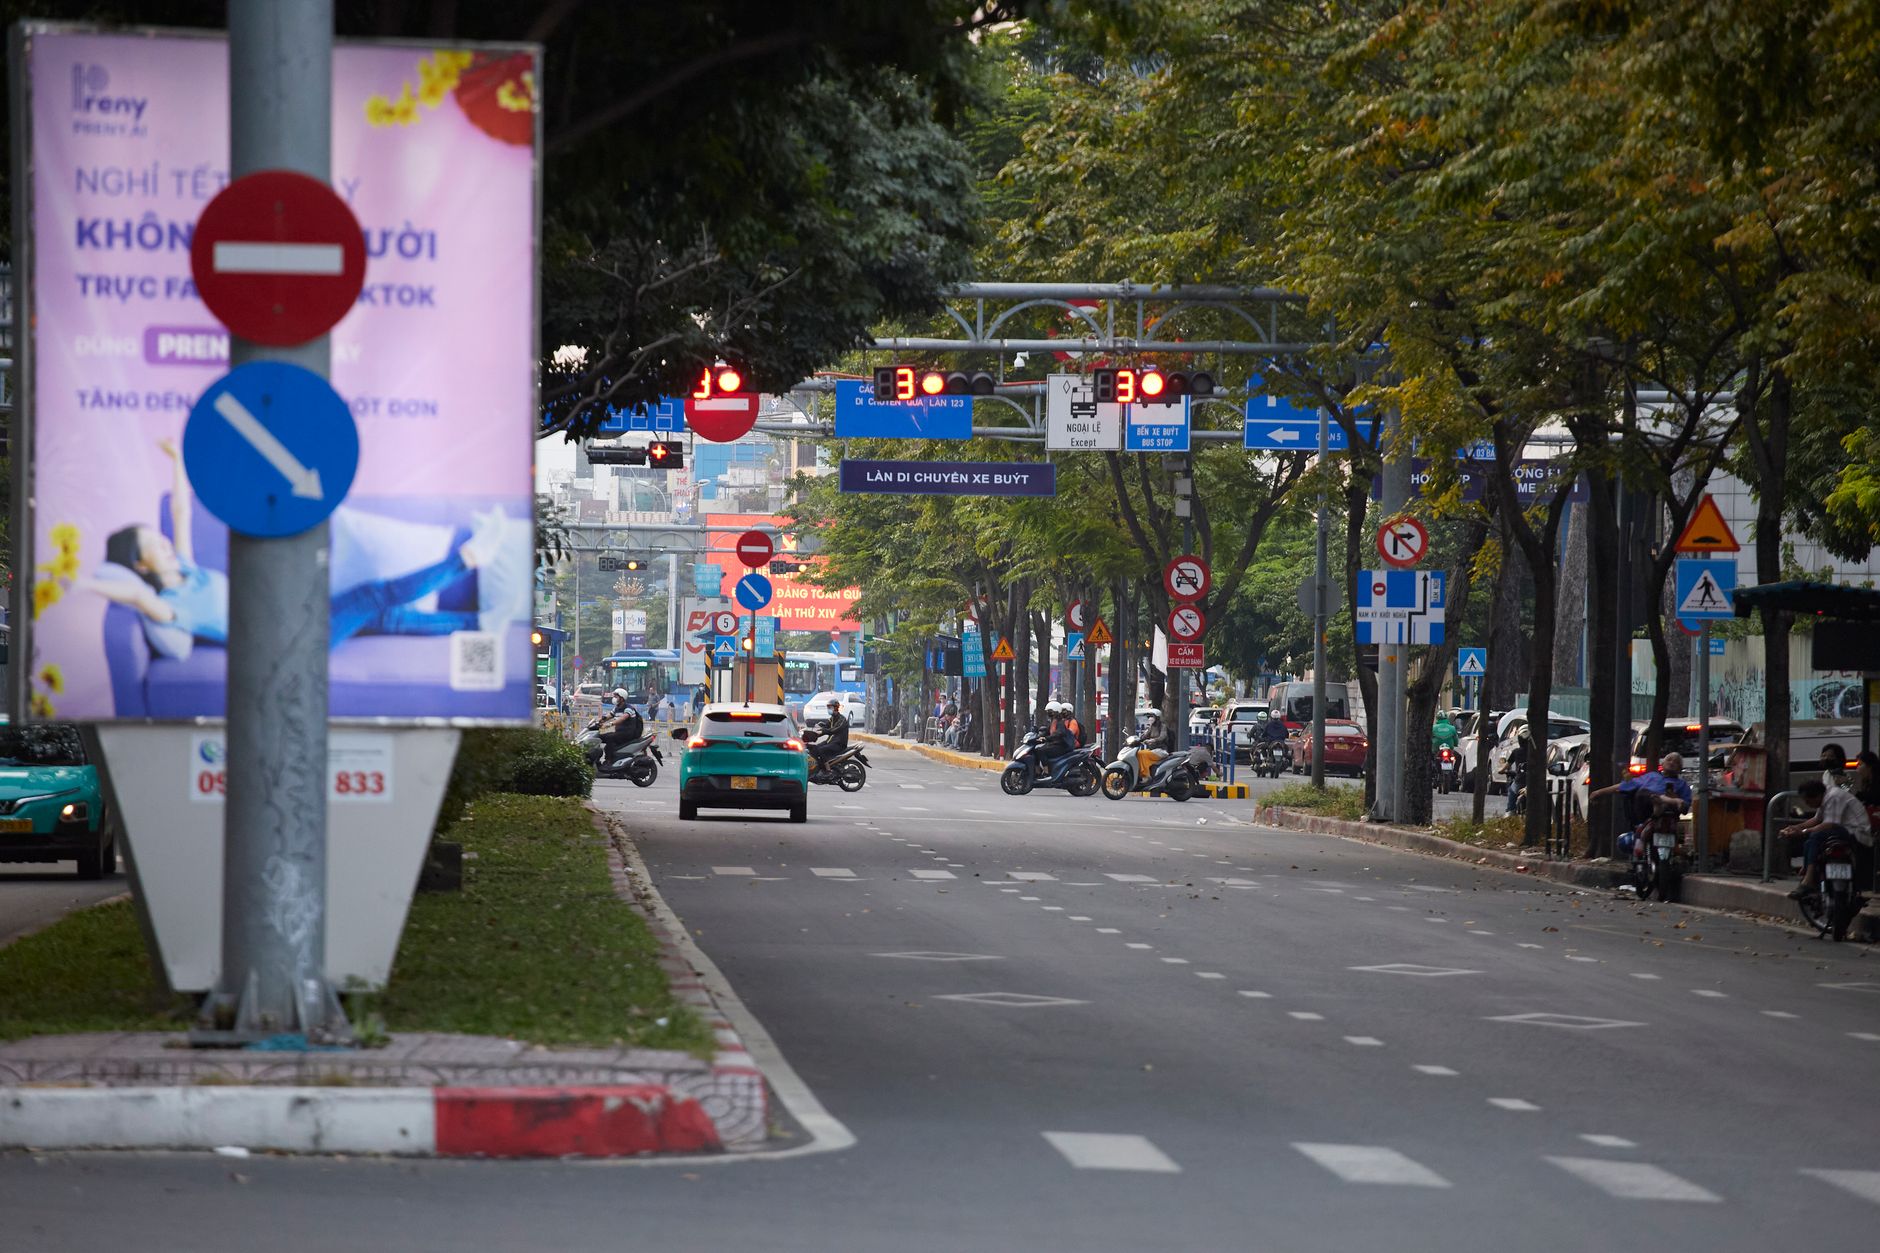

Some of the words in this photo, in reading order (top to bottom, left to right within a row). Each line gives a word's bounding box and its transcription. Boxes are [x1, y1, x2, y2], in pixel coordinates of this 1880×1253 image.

[76, 212, 195, 250] KHÔN
[364, 219, 437, 261] ƯỜI
[165, 276, 200, 301] FA
[359, 284, 435, 306] KTOK
[157, 332, 229, 360] PREN
[897, 368, 914, 400] 3
[1117, 370, 1134, 402] 3
[855, 397, 864, 406] DI
[929, 397, 947, 407] LÀN
[951, 399, 964, 408] 123
[1066, 423, 1090, 435] NGOẠI
[1092, 422, 1101, 436] LỆ
[1152, 427, 1161, 436] XE
[1070, 438, 1097, 447] Except
[1142, 438, 1155, 447] BUS
[1157, 438, 1174, 447] STOP
[866, 469, 893, 482] LÀN
[897, 471, 911, 482] DI
[972, 472, 991, 483] XE
[994, 471, 1029, 485] BUÝT
[843, 589, 861, 600] QU
[818, 608, 836, 618] XIV
[723, 617, 729, 629] 5
[1177, 645, 1194, 656] CẤM
[336, 770, 385, 794] 833
